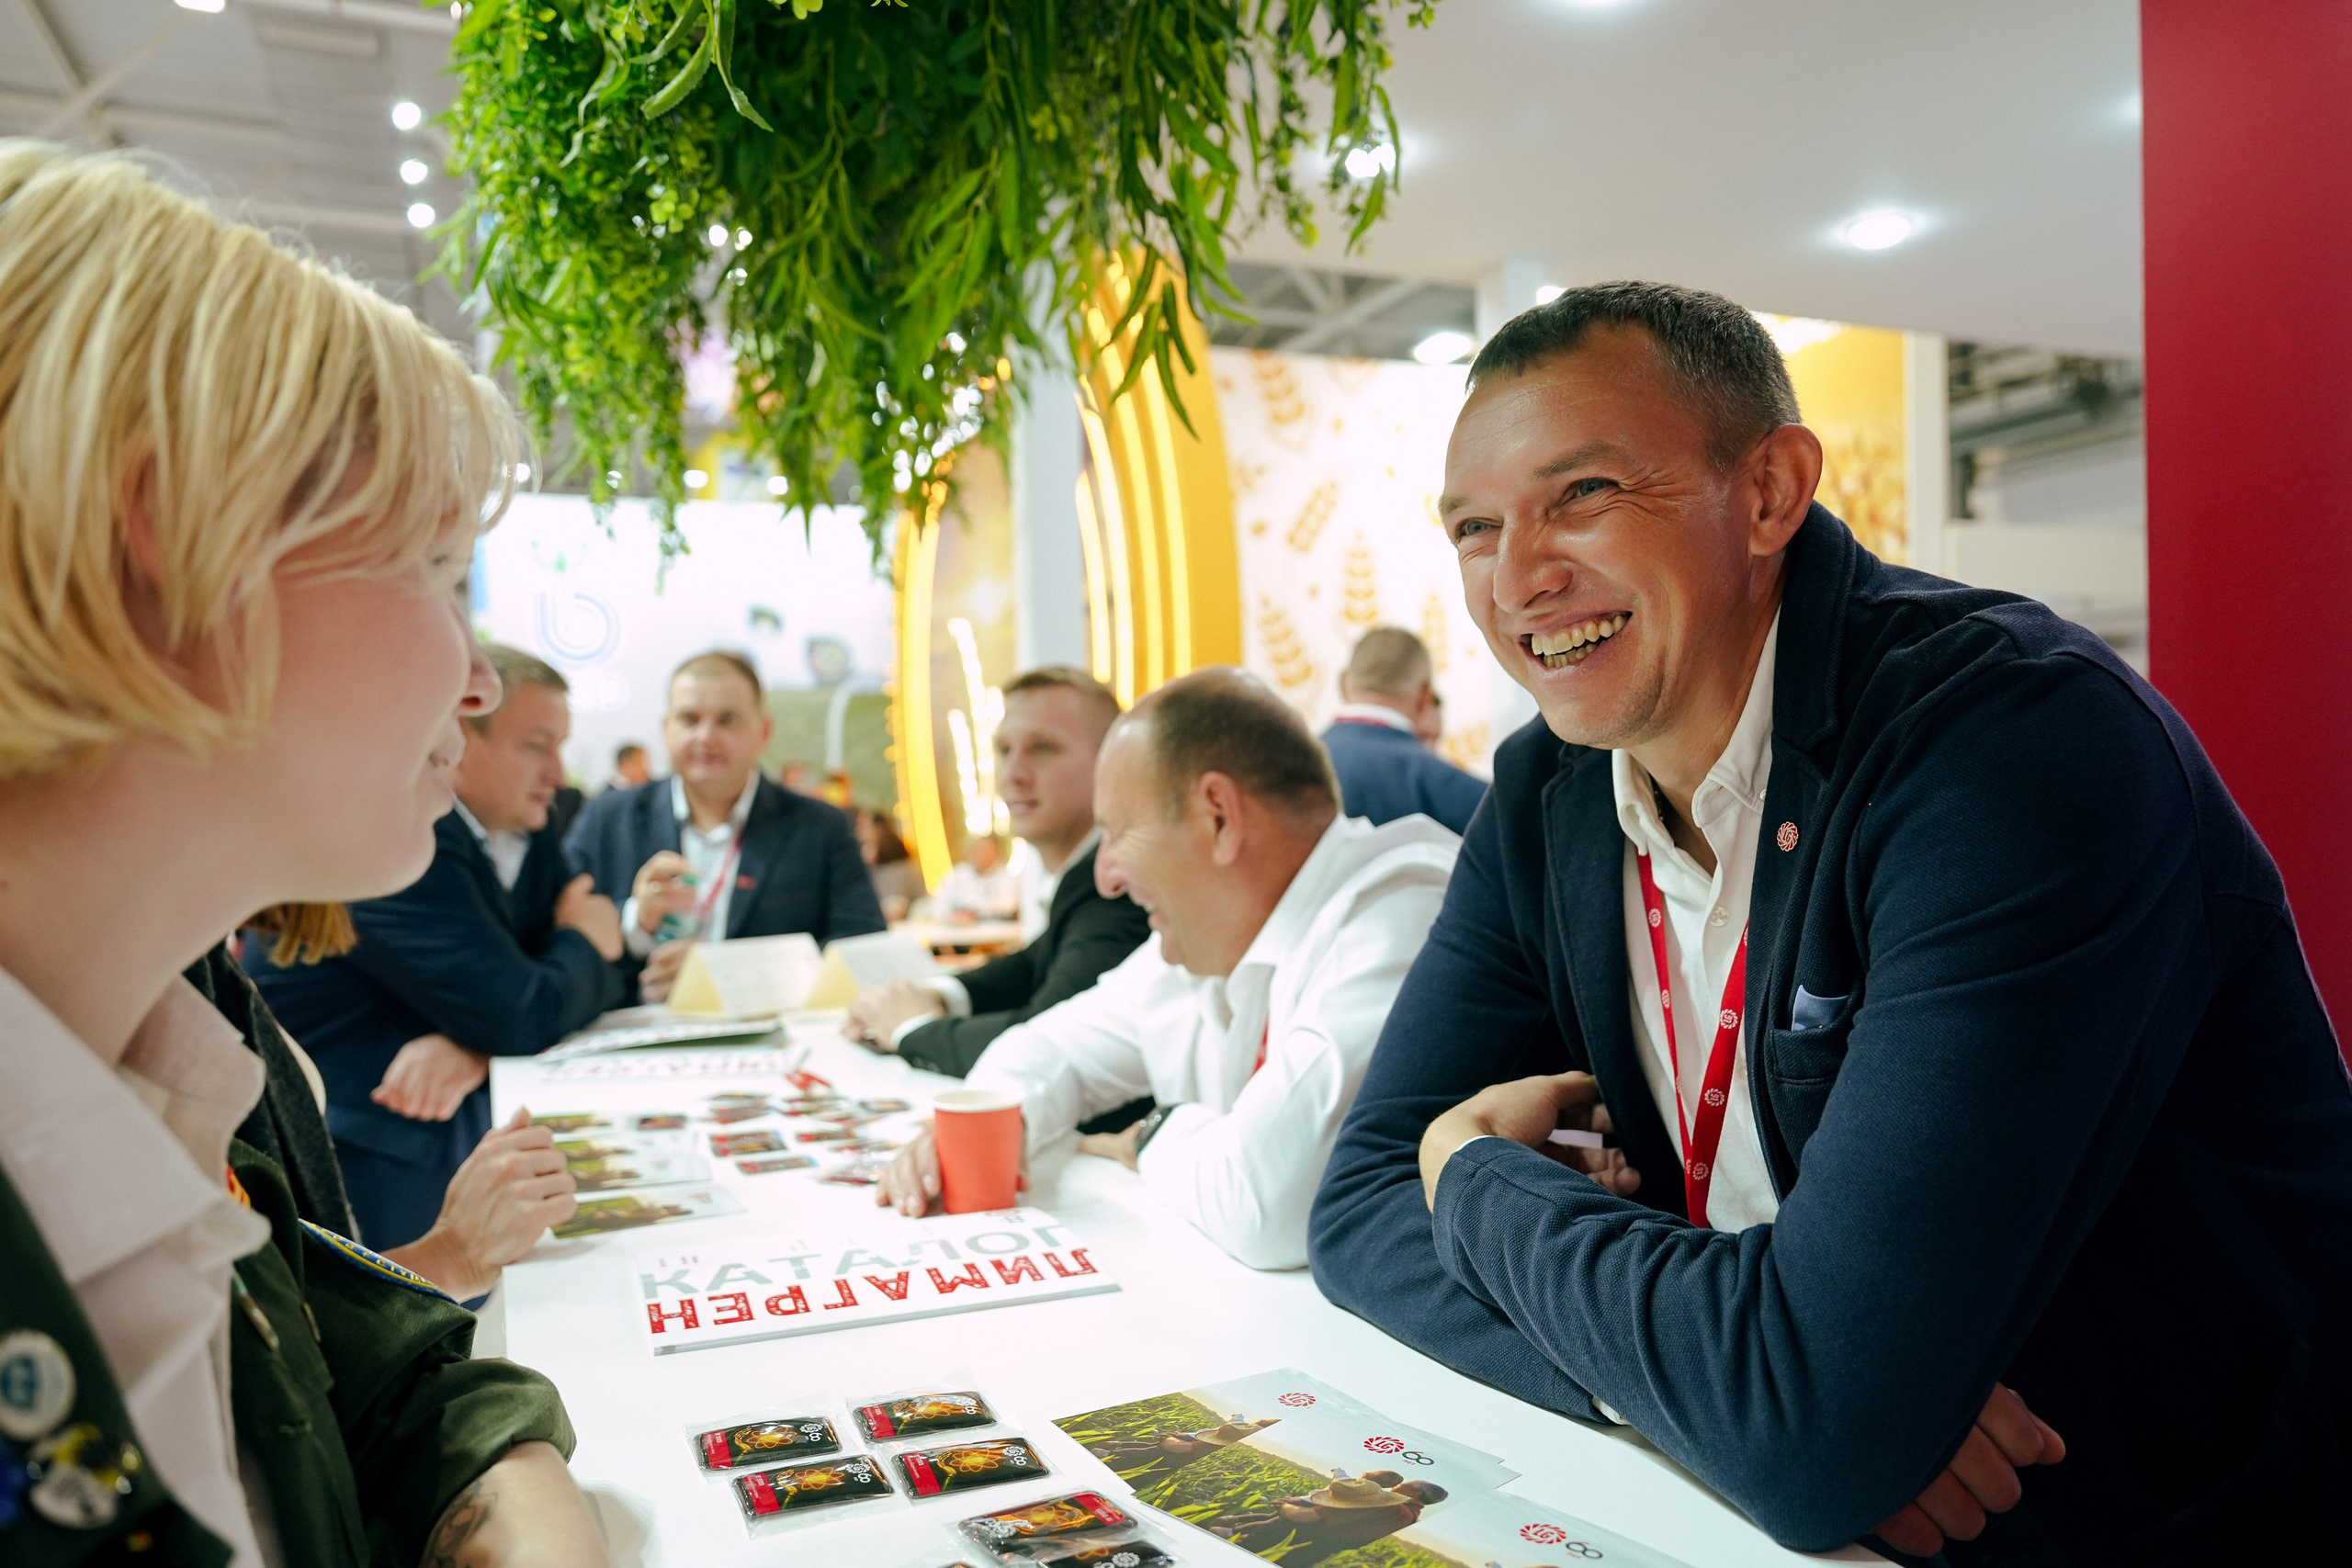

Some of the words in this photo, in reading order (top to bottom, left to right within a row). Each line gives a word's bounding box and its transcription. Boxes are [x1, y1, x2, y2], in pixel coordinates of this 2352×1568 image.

[640, 1224, 1064, 1299] КАТАЛОГ
[647, 1247, 1099, 1334] ЛИМАГРЕН
[1402, 1450, 1435, 1466] 60
[1565, 1540, 1603, 1559] 60
